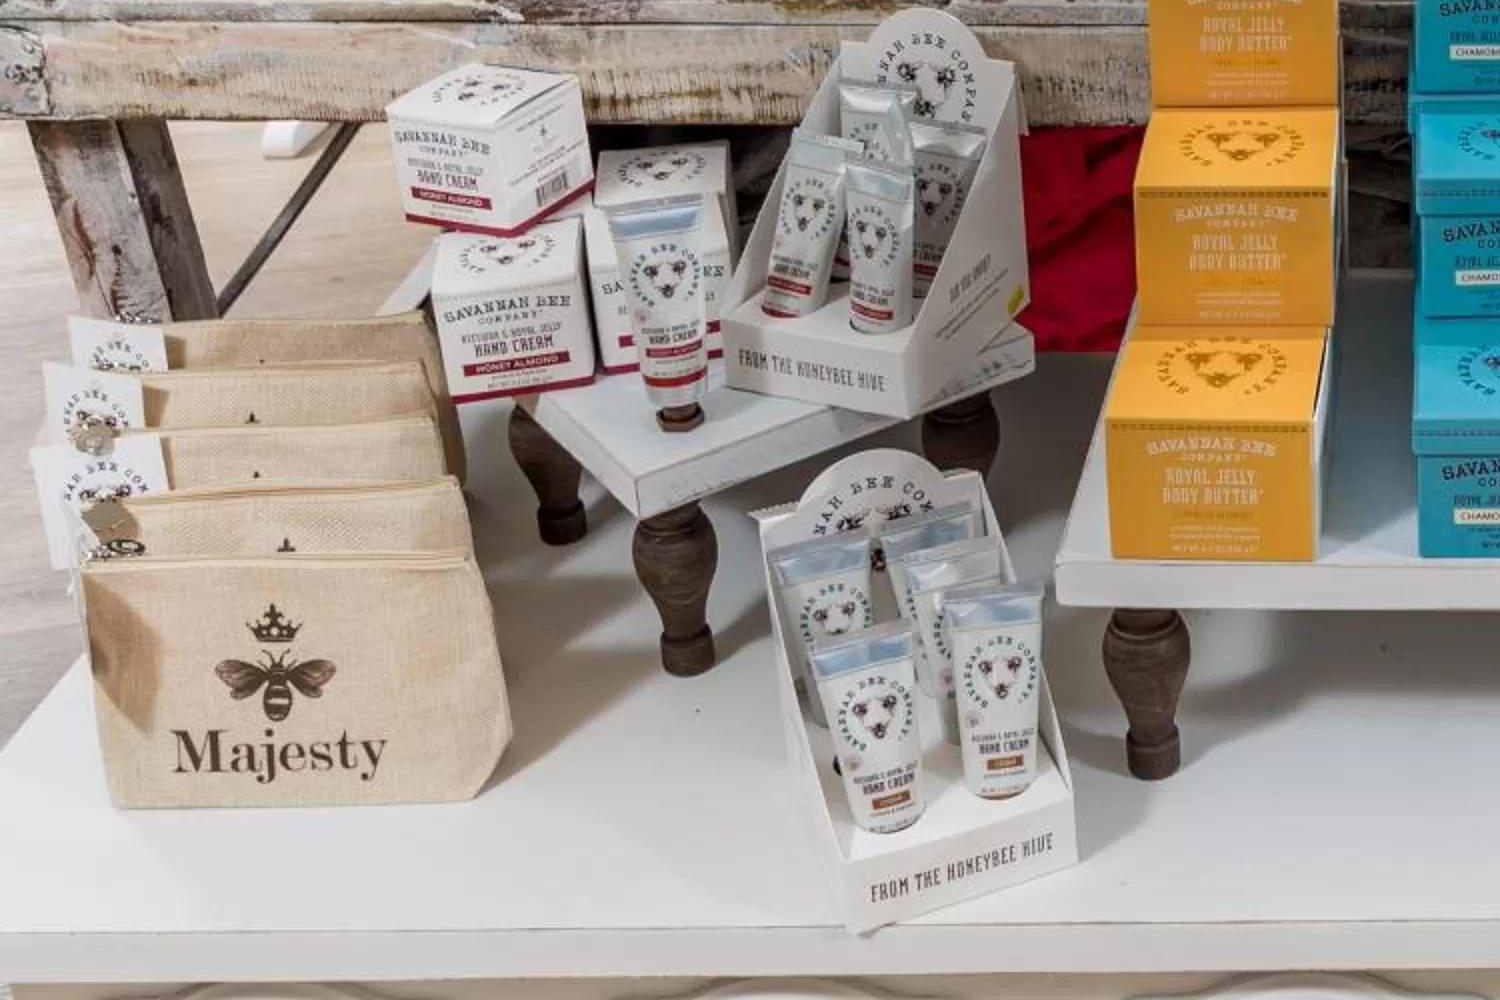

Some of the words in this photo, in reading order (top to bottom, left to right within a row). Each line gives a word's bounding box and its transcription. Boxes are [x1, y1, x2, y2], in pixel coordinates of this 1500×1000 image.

[911, 31, 946, 49] BEE
[394, 130, 457, 148] SAVANNAH
[462, 137, 490, 155] BEE
[417, 171, 441, 185] HAND
[445, 174, 478, 191] CREAM
[444, 297, 530, 324] SAVANNAH
[536, 295, 571, 308] BEE
[474, 340, 507, 356] HAND
[513, 335, 554, 352] CREAM
[476, 360, 511, 374] HONEY
[513, 354, 559, 368] ALMOND
[738, 348, 769, 372] FROM
[772, 355, 793, 377] THE
[796, 360, 856, 387] HONEYBEE
[857, 368, 886, 393] HIVE
[1148, 435, 1235, 456] SAVANNAH
[1241, 438, 1280, 457] BEE
[850, 475, 893, 496] BEE
[1165, 467, 1210, 484] ROYAL
[1216, 467, 1256, 484] JELLY
[1162, 488, 1199, 504] BODY
[1204, 487, 1259, 505] BUTTER
[170, 728, 388, 785] Majesty
[871, 876, 909, 902] FROM
[914, 866, 941, 892] THE
[946, 846, 1016, 882] HONEYBEE
[1022, 834, 1054, 855] HIVE
